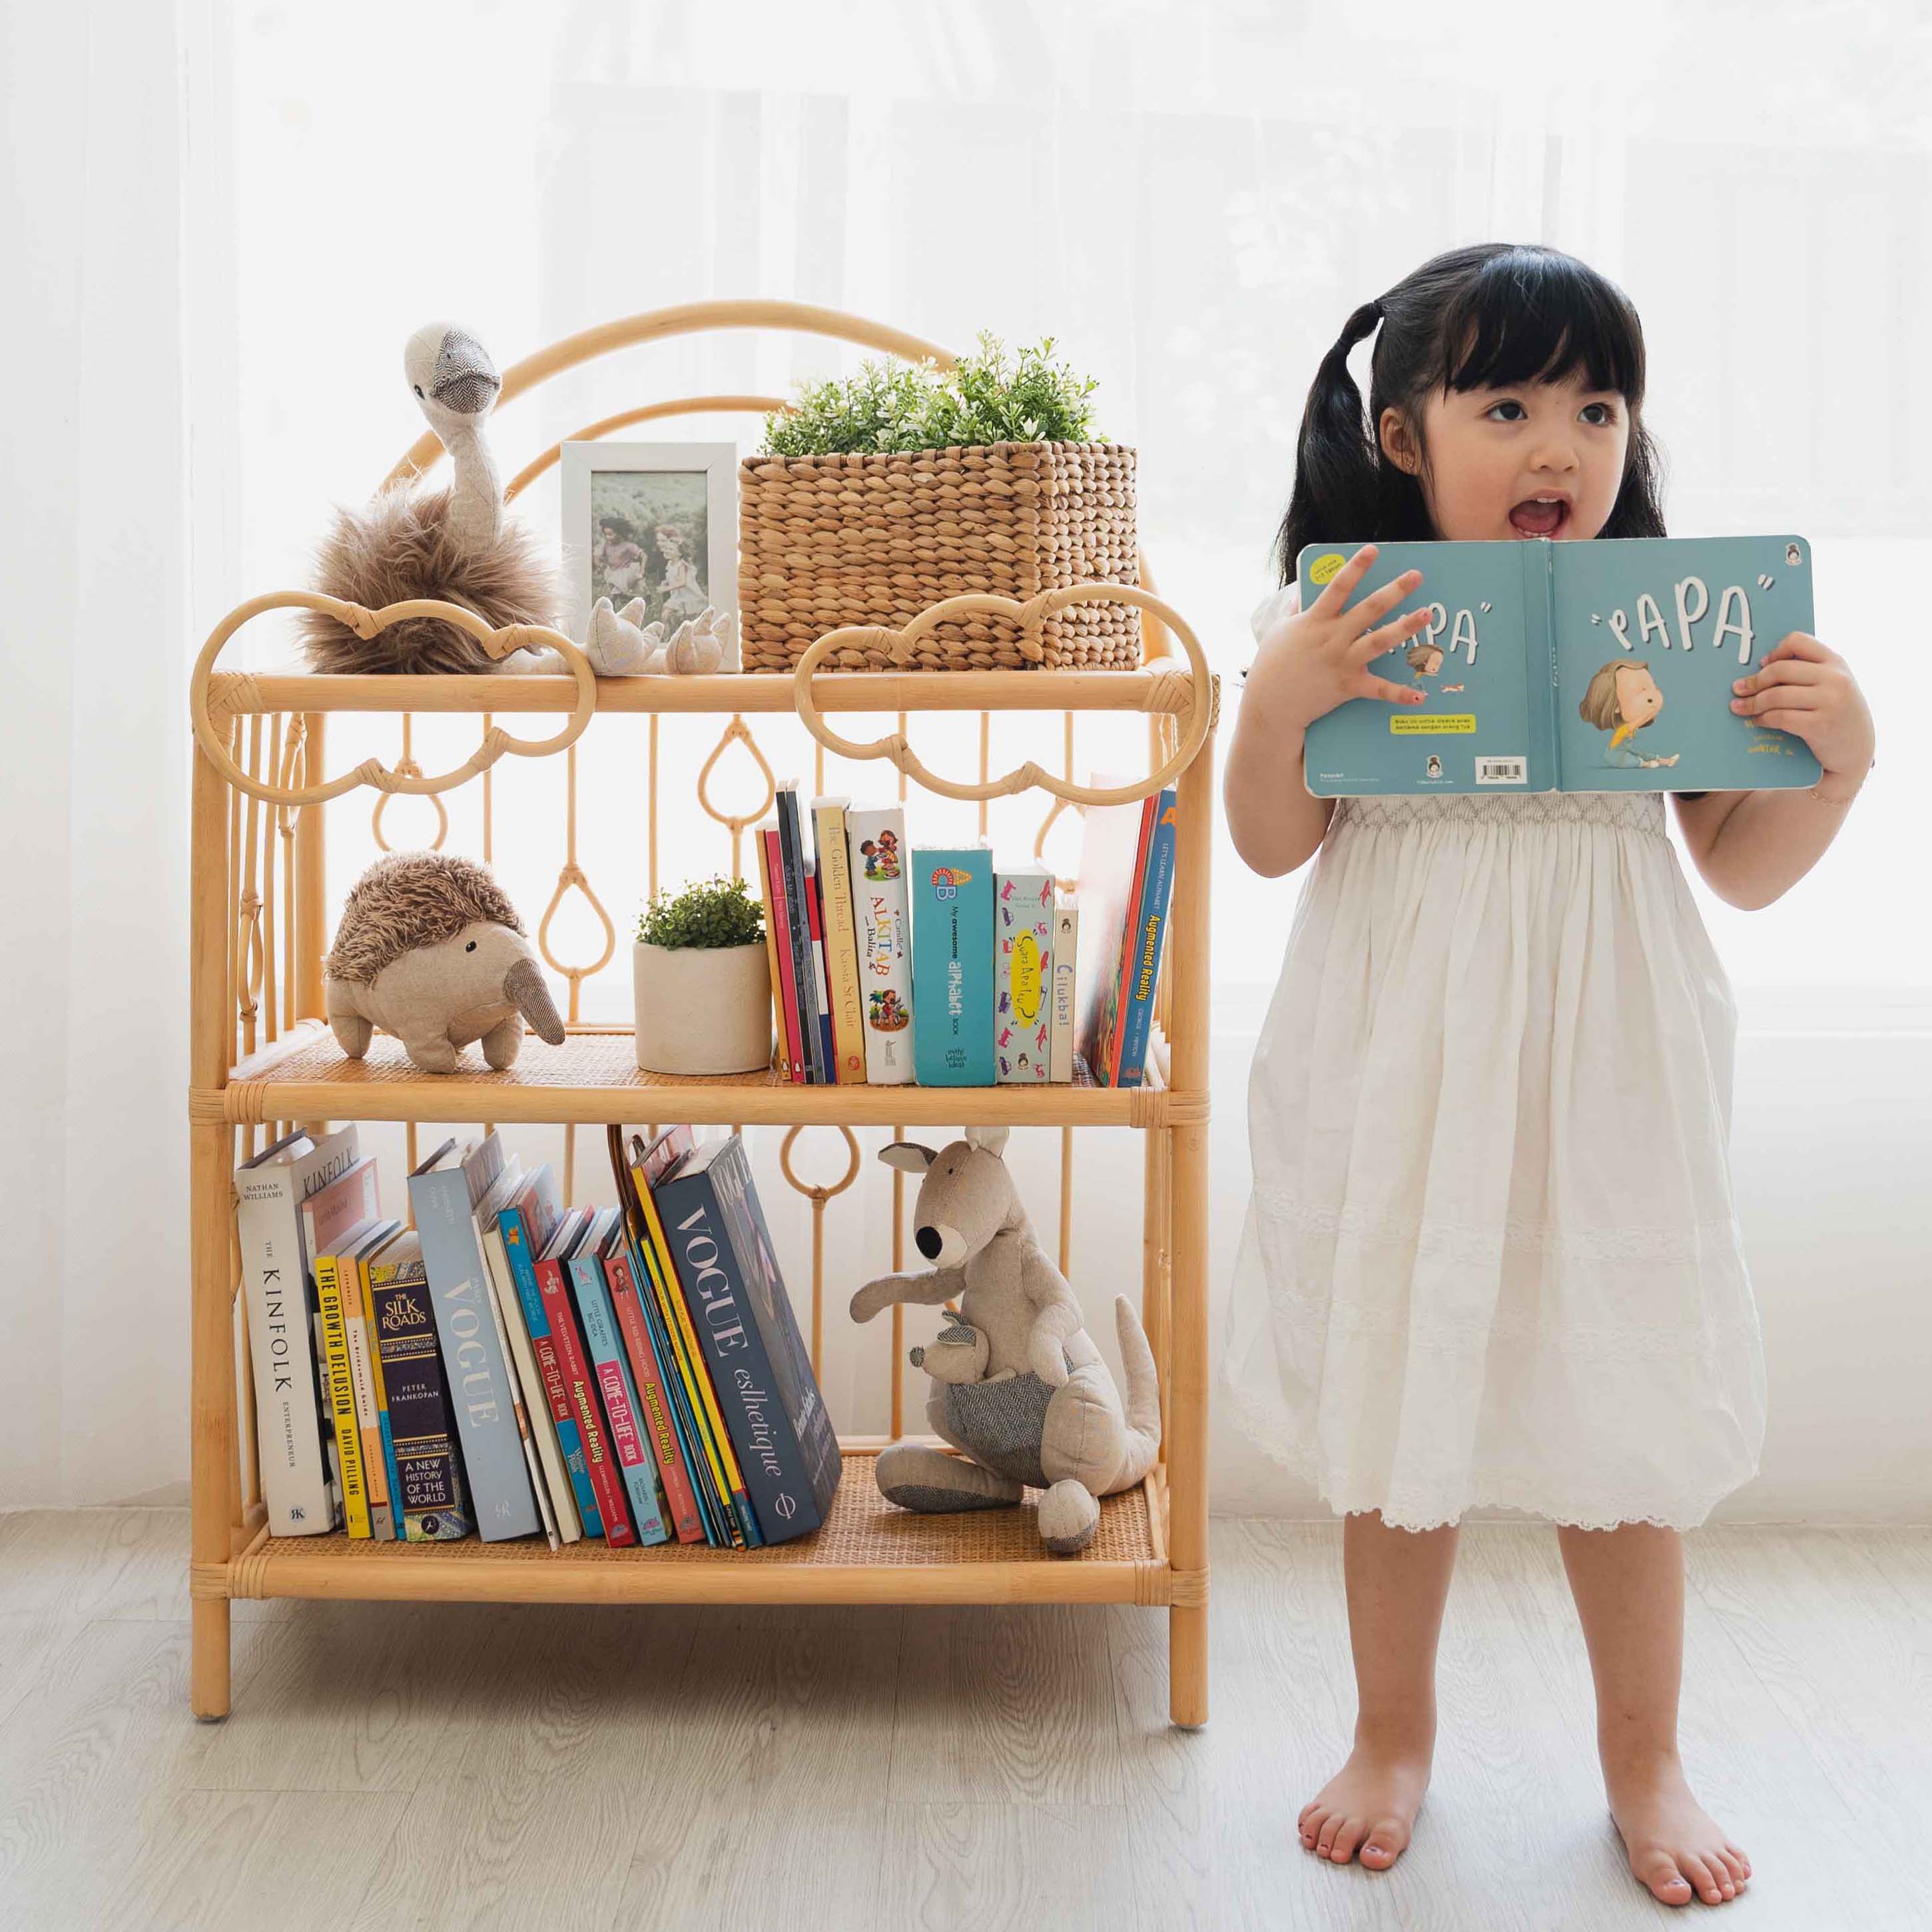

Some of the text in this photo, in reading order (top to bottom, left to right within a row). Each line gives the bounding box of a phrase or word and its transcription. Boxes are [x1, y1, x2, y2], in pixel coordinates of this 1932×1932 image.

[830, 849, 843, 890] Golden
[834, 892, 849, 933] Thread
[951, 906, 958, 917] My
[866, 927, 876, 958] Balita
[869, 896, 893, 976] ALKITAB
[1135, 914, 1161, 1003] Augmented Reality
[948, 962, 962, 1016] alphabet
[1057, 964, 1073, 1026] Cilukba!
[843, 1000, 856, 1029] Clair
[243, 1190, 284, 1201] WILLIAMS
[246, 1183, 278, 1192] NATHAN
[677, 1204, 749, 1357] VOGUE
[382, 1312, 426, 1331] ROADS
[385, 1299, 420, 1317] SILK
[263, 1268, 292, 1392] KINFOLK
[319, 1267, 352, 1415] THE GROWTH DELUSION
[443, 1281, 500, 1429] VOGUE
[392, 1391, 439, 1403] FRANKOPAN
[539, 1347, 565, 1399] COME-TO-LIFE
[557, 1403, 569, 1417] BOOK
[573, 1381, 603, 1464] Augmented Reality
[602, 1374, 632, 1441] COME-TO-LIFE
[623, 1444, 636, 1461] BOOK
[643, 1382, 675, 1464] Augmented Reality
[341, 1429, 360, 1496] DAVID PILLING
[406, 1470, 442, 1481] HISTORY
[416, 1458, 440, 1470] NEW
[569, 1453, 578, 1473] Pooh
[407, 1481, 444, 1494] OF THE
[408, 1492, 446, 1504] WORLD
